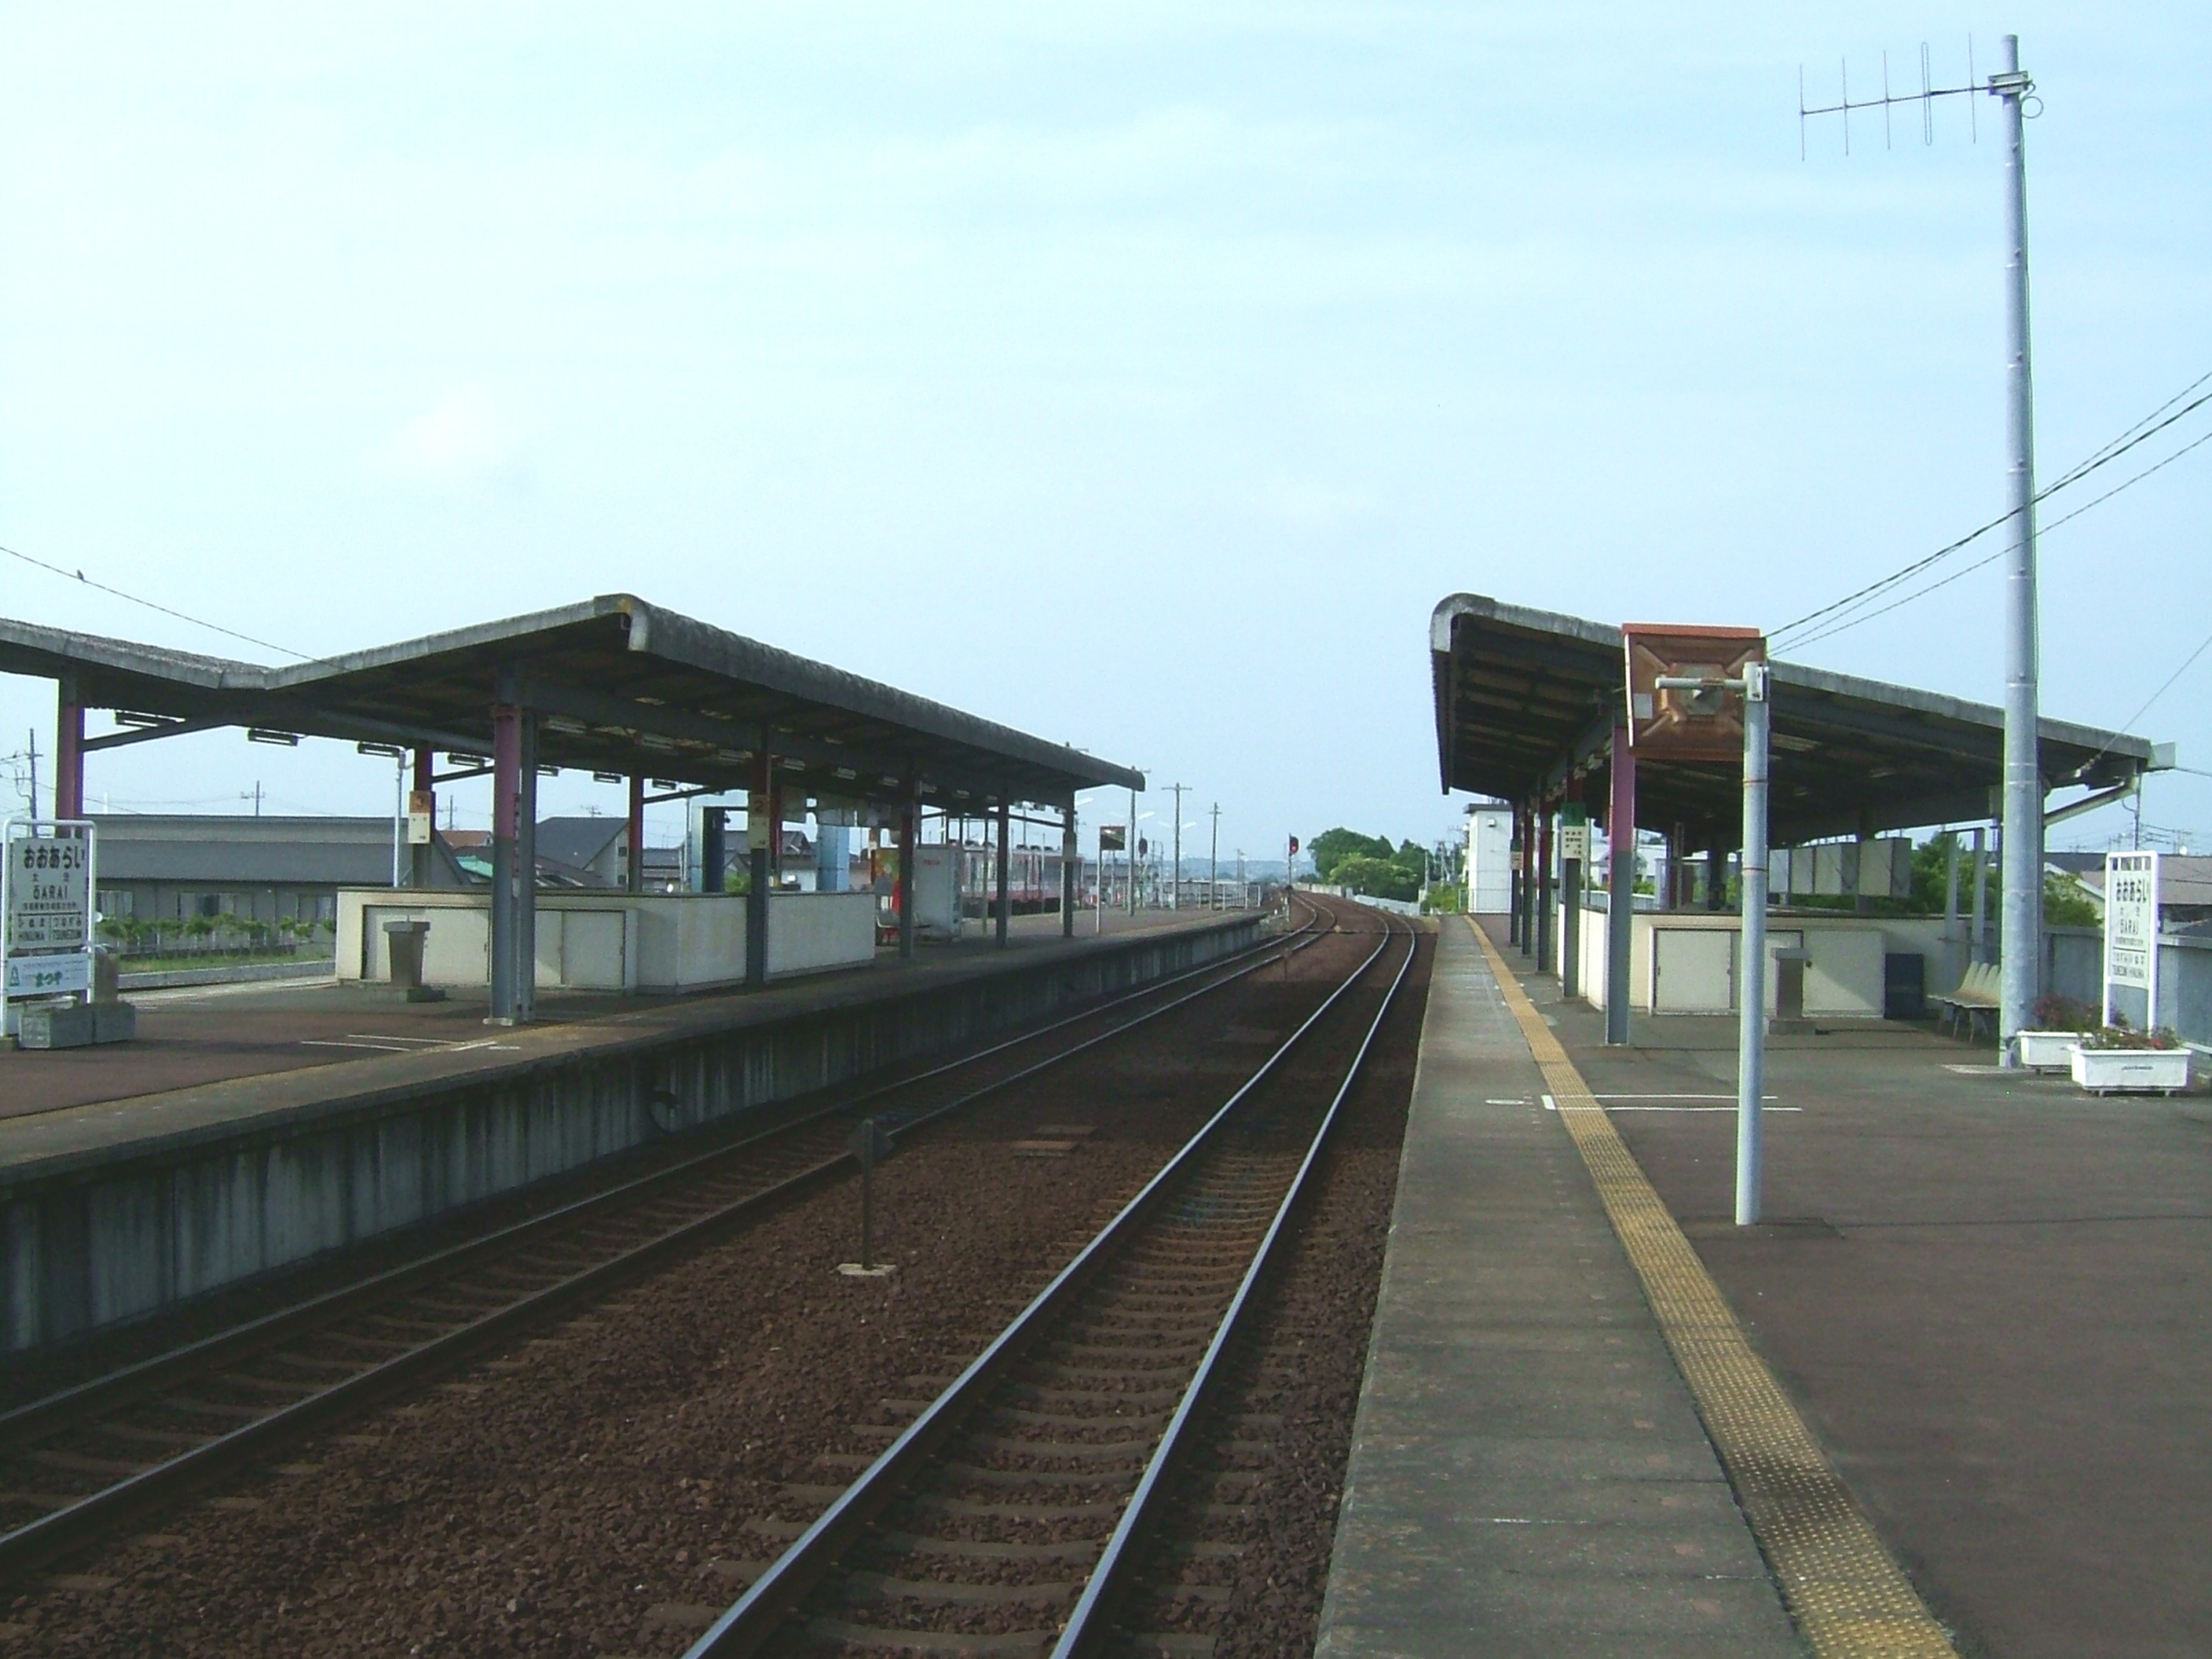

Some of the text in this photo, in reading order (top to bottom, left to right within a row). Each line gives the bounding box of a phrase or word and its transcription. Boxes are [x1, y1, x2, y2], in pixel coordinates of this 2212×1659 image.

[754, 800, 764, 813] 2
[24, 844, 85, 869] おおあらい
[2115, 878, 2151, 903] おおあらい
